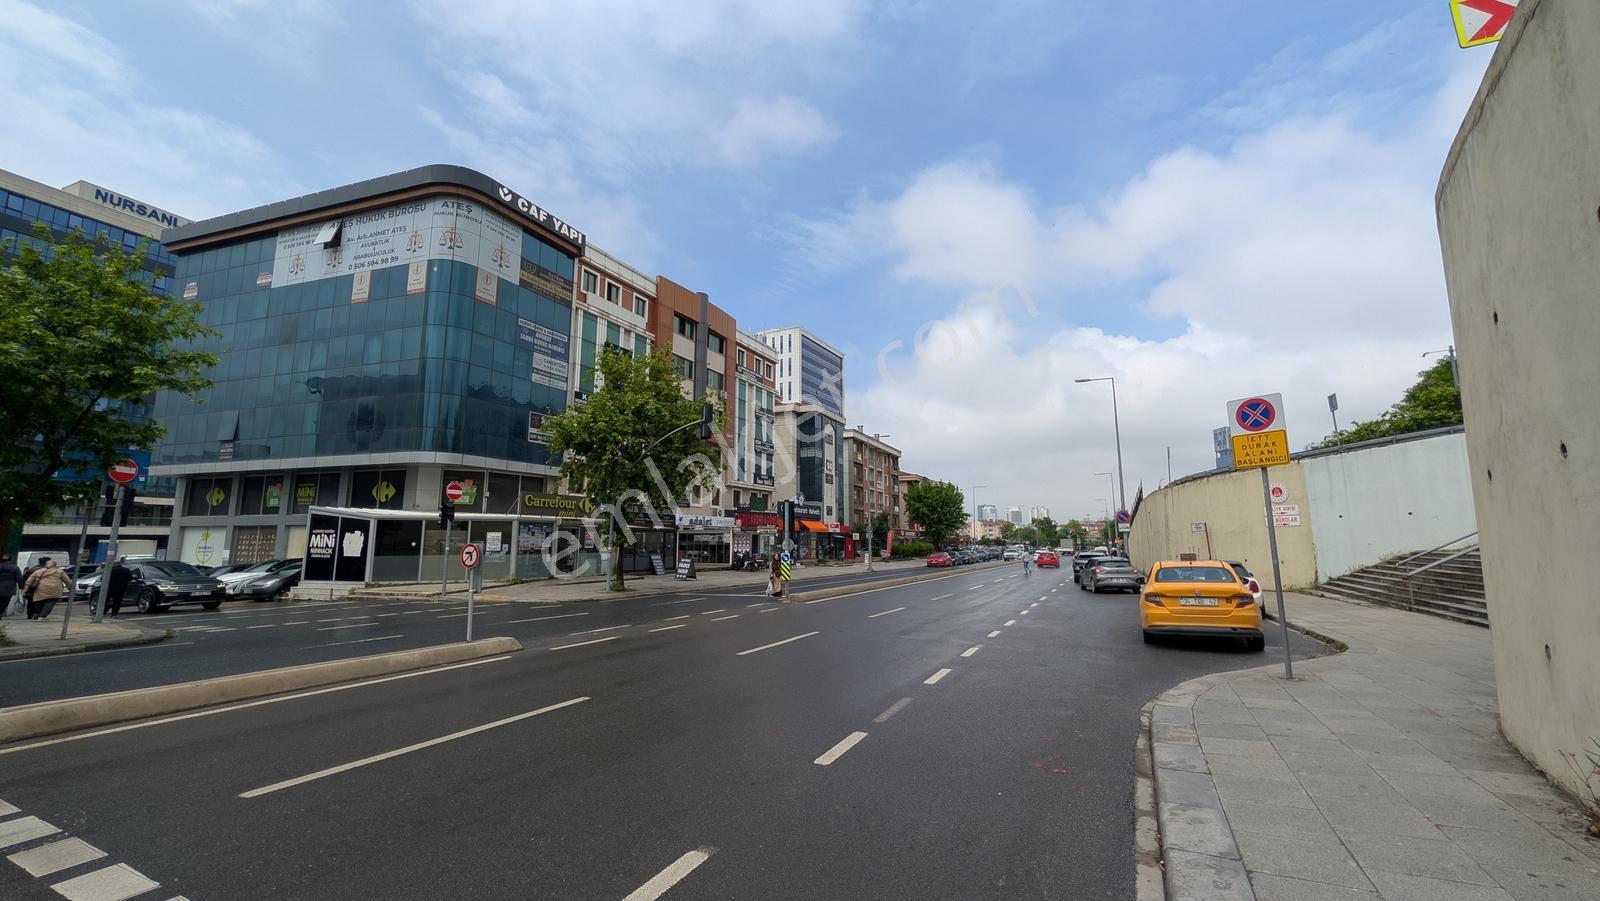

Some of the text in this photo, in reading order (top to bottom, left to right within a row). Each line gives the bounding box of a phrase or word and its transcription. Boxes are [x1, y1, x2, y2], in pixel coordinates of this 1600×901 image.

[355, 211, 387, 226] HUKUK
[388, 202, 427, 219] BÜROSU
[441, 199, 473, 215] ATEŞ
[433, 210, 483, 225] HUKUK BÜROSU
[517, 197, 548, 224] CAF
[553, 216, 583, 245] YAPI
[391, 224, 408, 234] ATEŞ
[360, 238, 391, 249] AVUKATLIK
[352, 247, 397, 261] ARABULUCULUK
[354, 261, 366, 270] 506
[380, 257, 389, 265] 98
[390, 255, 399, 263] 99
[1241, 440, 1279, 451] DURAK
[1244, 448, 1278, 458] ALANI
[524, 494, 577, 509] Carrefour
